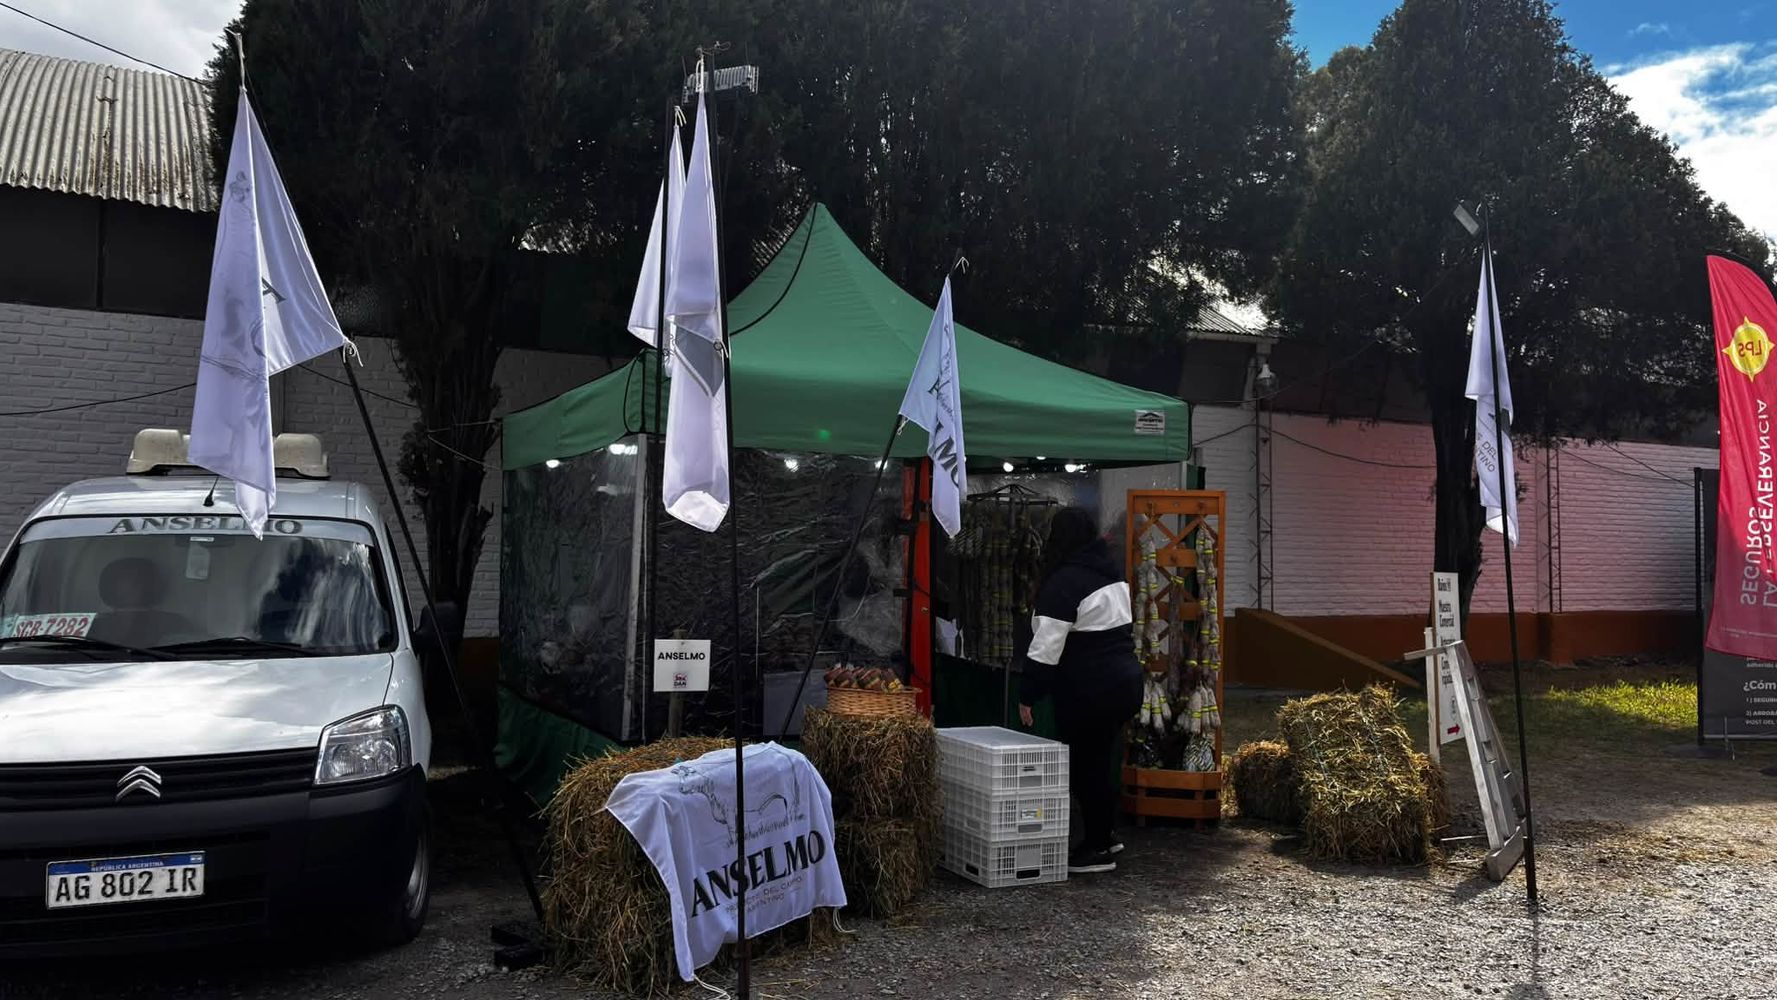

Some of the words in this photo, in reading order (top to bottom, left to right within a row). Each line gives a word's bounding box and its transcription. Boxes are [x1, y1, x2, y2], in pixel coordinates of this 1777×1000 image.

[657, 651, 706, 661] ANSELMO
[55, 876, 91, 903] AG
[100, 870, 155, 899] 802
[165, 867, 197, 893] IR
[691, 829, 826, 918] ANSELMO
